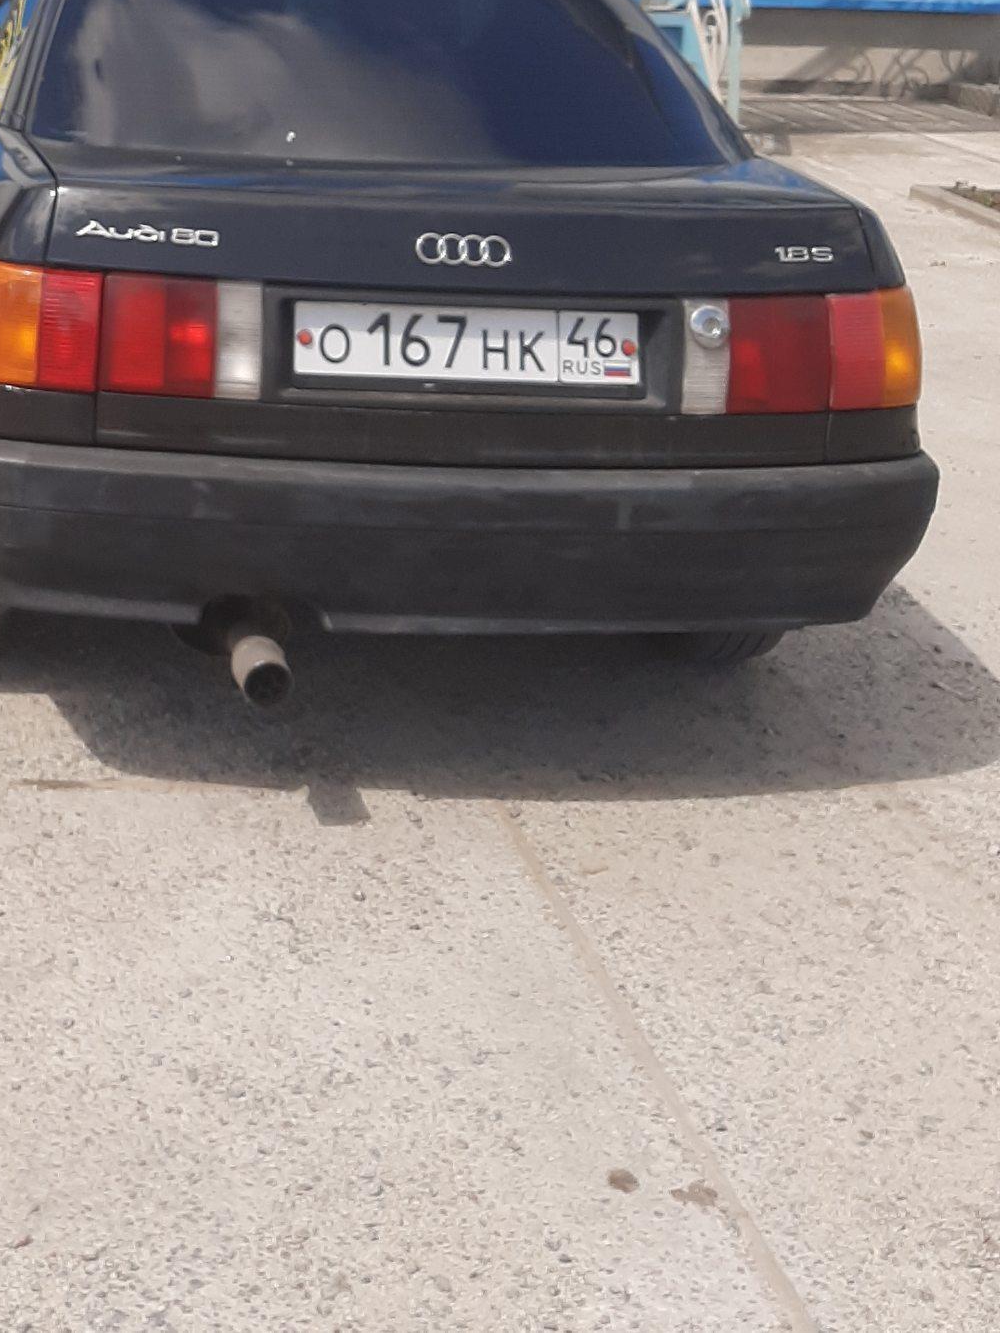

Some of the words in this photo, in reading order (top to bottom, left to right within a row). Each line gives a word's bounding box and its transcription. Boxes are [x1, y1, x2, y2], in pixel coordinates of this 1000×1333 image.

[171, 227, 220, 247] 80
[566, 316, 618, 359] 46
[562, 359, 602, 376] RUS
